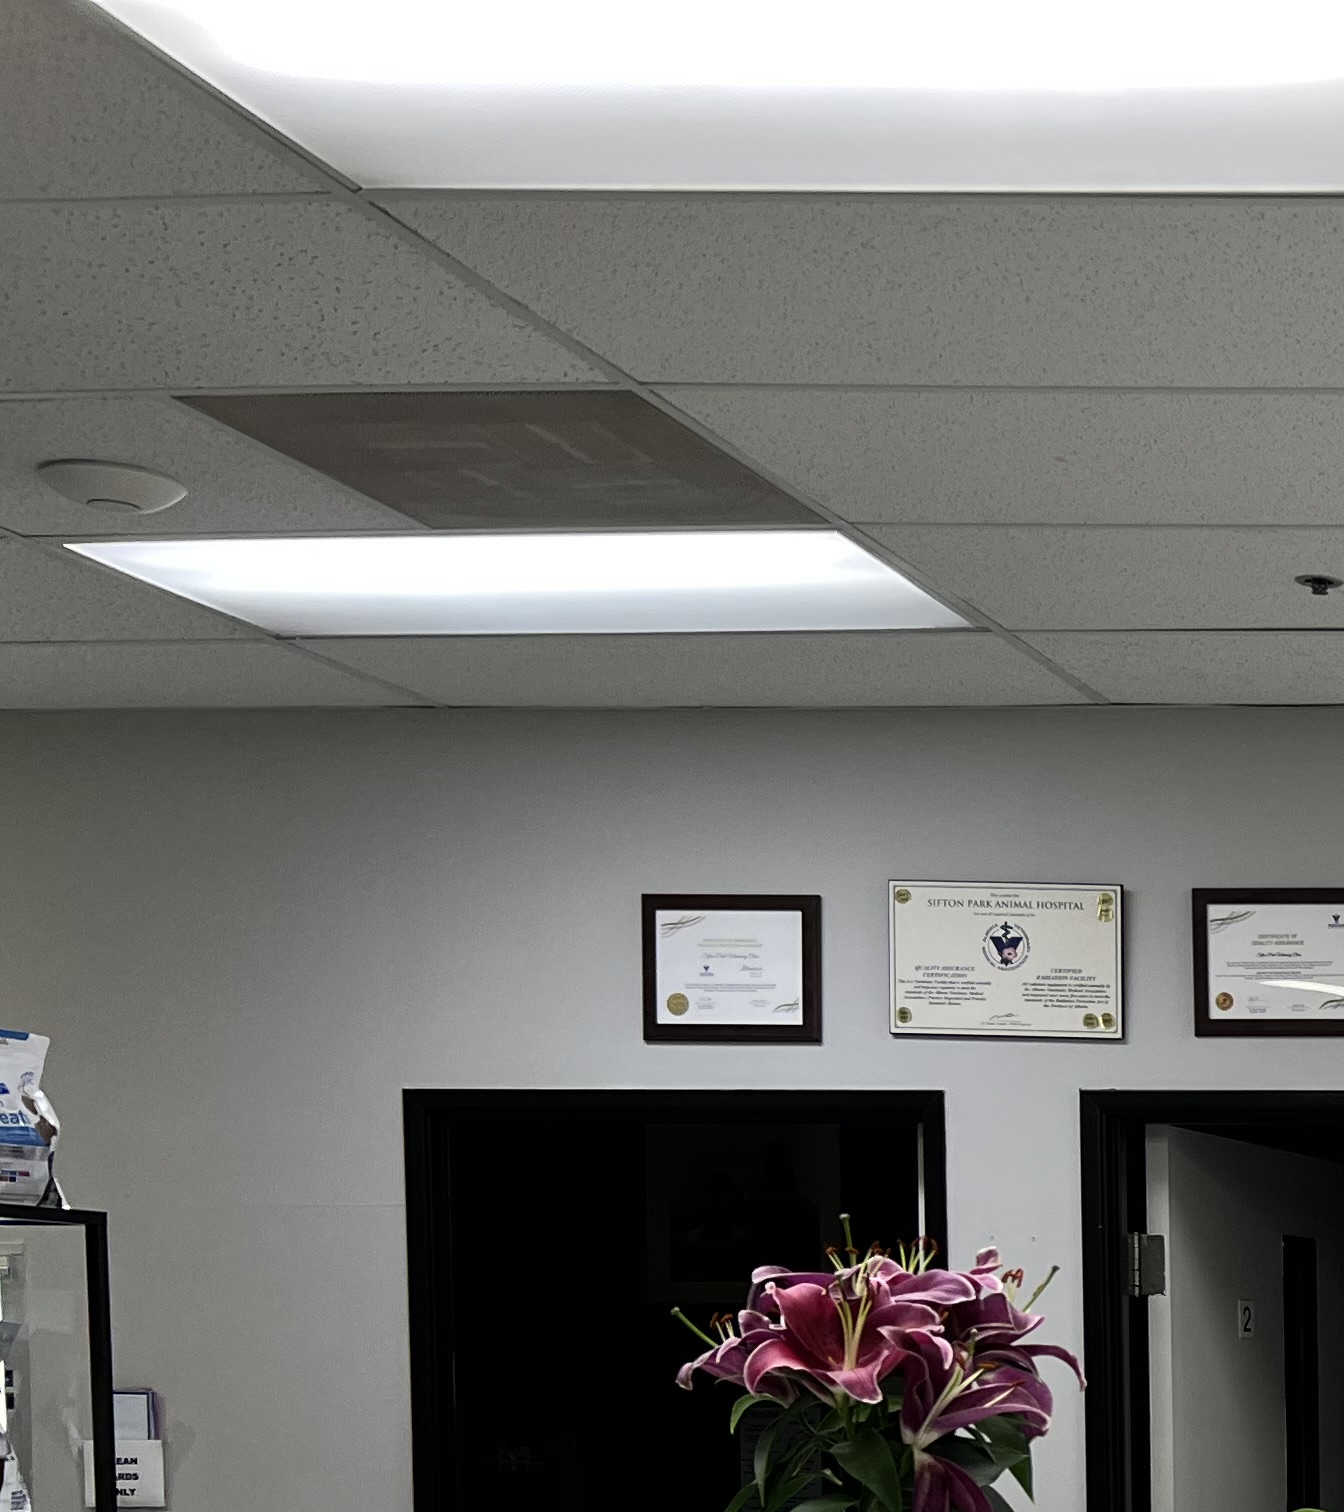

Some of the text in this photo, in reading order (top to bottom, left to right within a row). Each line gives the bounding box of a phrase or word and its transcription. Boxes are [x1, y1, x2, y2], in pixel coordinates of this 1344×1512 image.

[927, 898, 1085, 911] SIFTON PARK ANIMAL HOSPITAL
[114, 1457, 139, 1466] EAN
[114, 1488, 137, 1497] NLY
